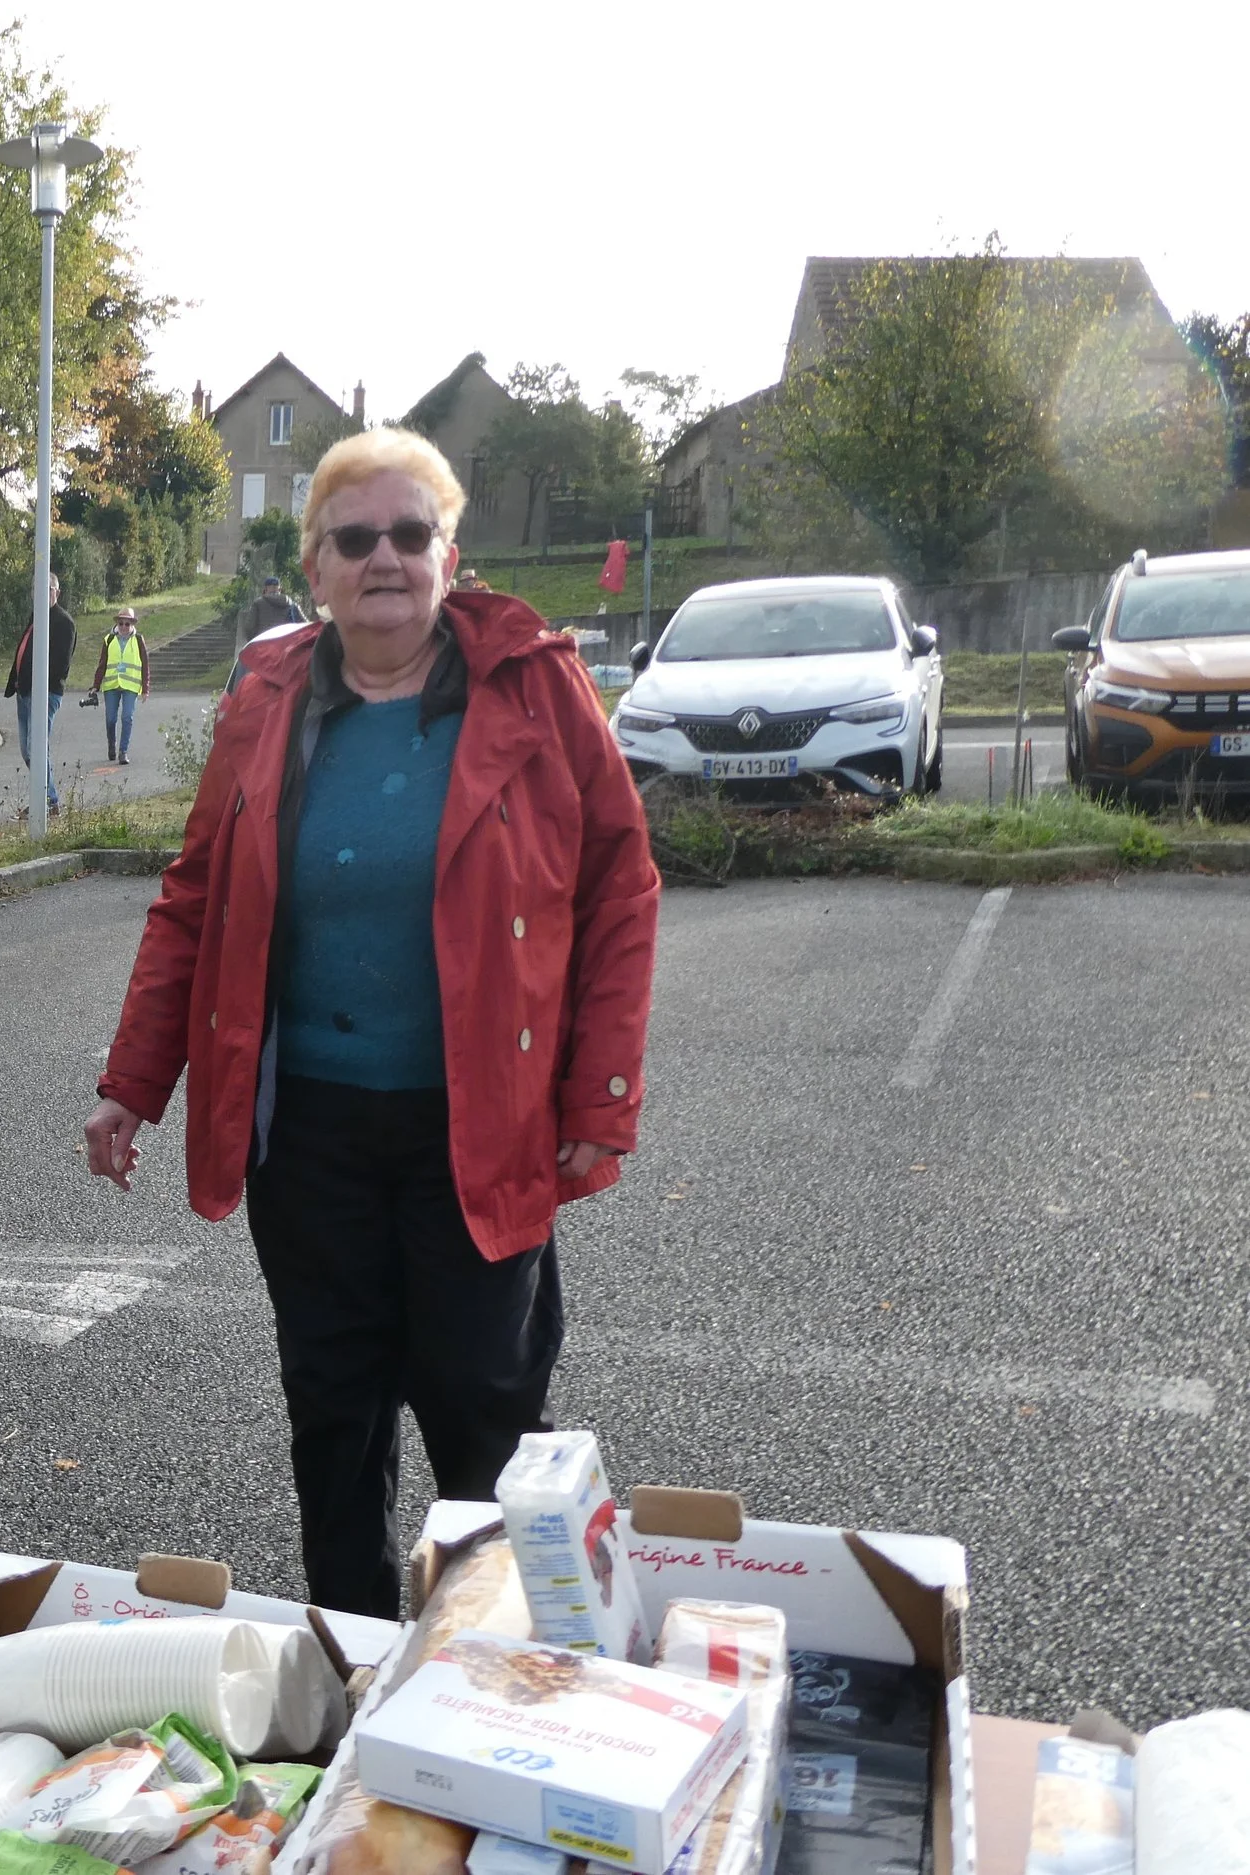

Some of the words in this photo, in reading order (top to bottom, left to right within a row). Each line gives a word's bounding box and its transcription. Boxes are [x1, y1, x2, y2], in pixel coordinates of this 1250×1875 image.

[713, 758, 787, 776] GV-413-DX
[627, 1544, 705, 1572] rigine
[712, 1547, 809, 1576] France
[669, 1704, 705, 1722] x6
[575, 1728, 657, 1758] CHOCOLAT
